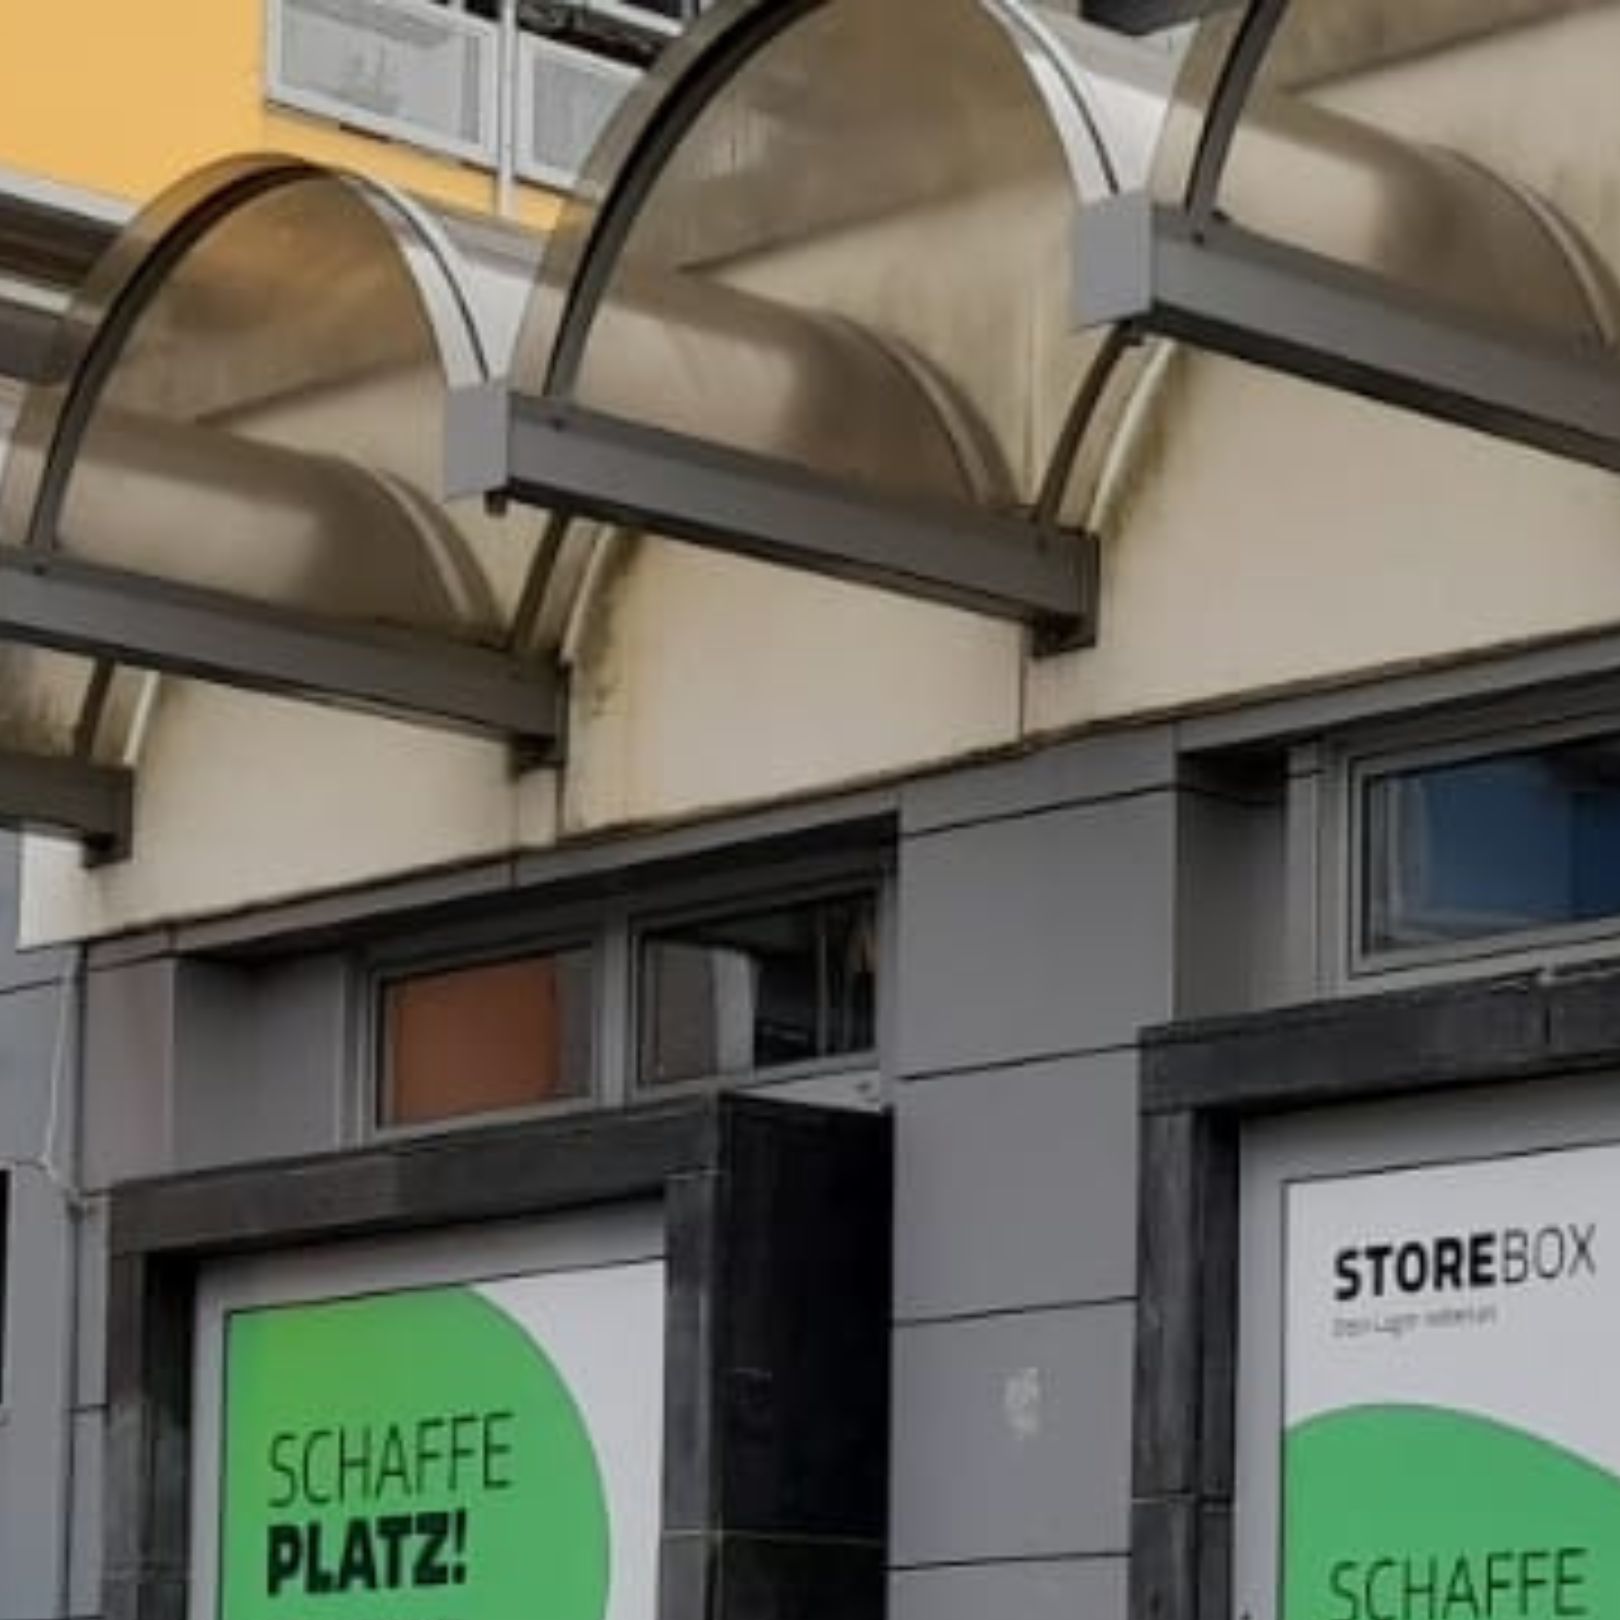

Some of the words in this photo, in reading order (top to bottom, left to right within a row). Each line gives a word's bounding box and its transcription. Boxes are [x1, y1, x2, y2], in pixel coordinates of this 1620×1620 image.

[1333, 1223, 1597, 1301] STOREBOX
[269, 1411, 514, 1507] SCHAFFE
[267, 1507, 468, 1597] PLATZ!
